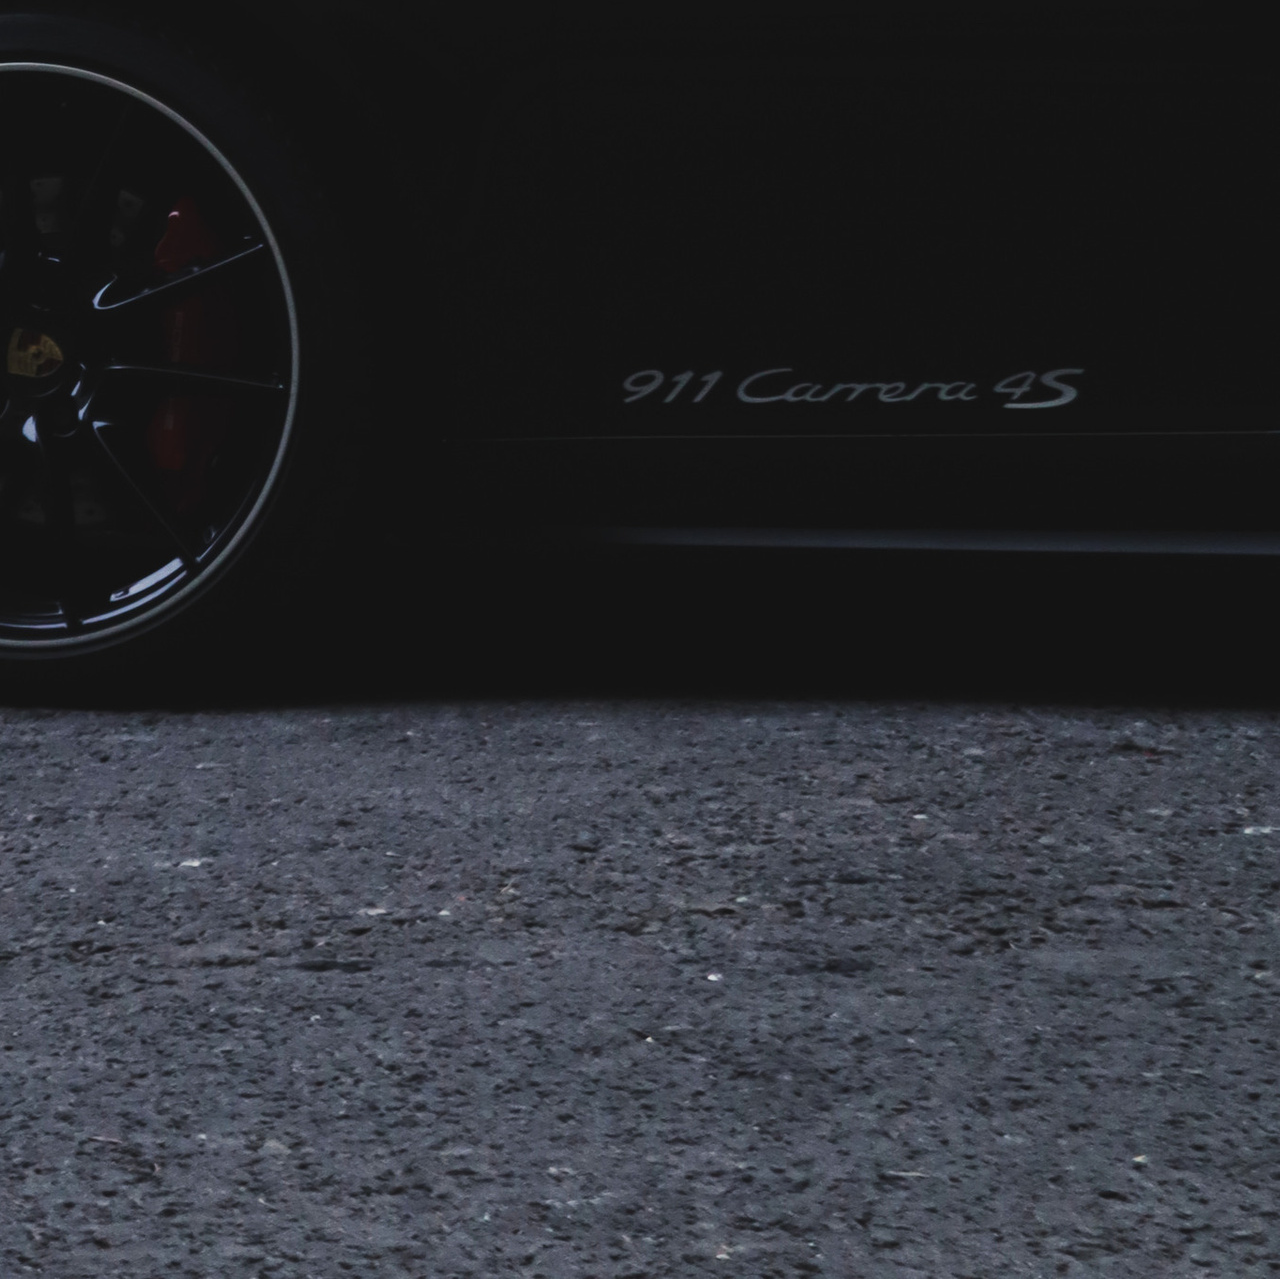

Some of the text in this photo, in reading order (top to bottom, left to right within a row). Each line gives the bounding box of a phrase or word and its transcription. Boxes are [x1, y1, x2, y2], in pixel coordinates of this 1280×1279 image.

[622, 368, 1086, 410] 911 Carrera 4S
